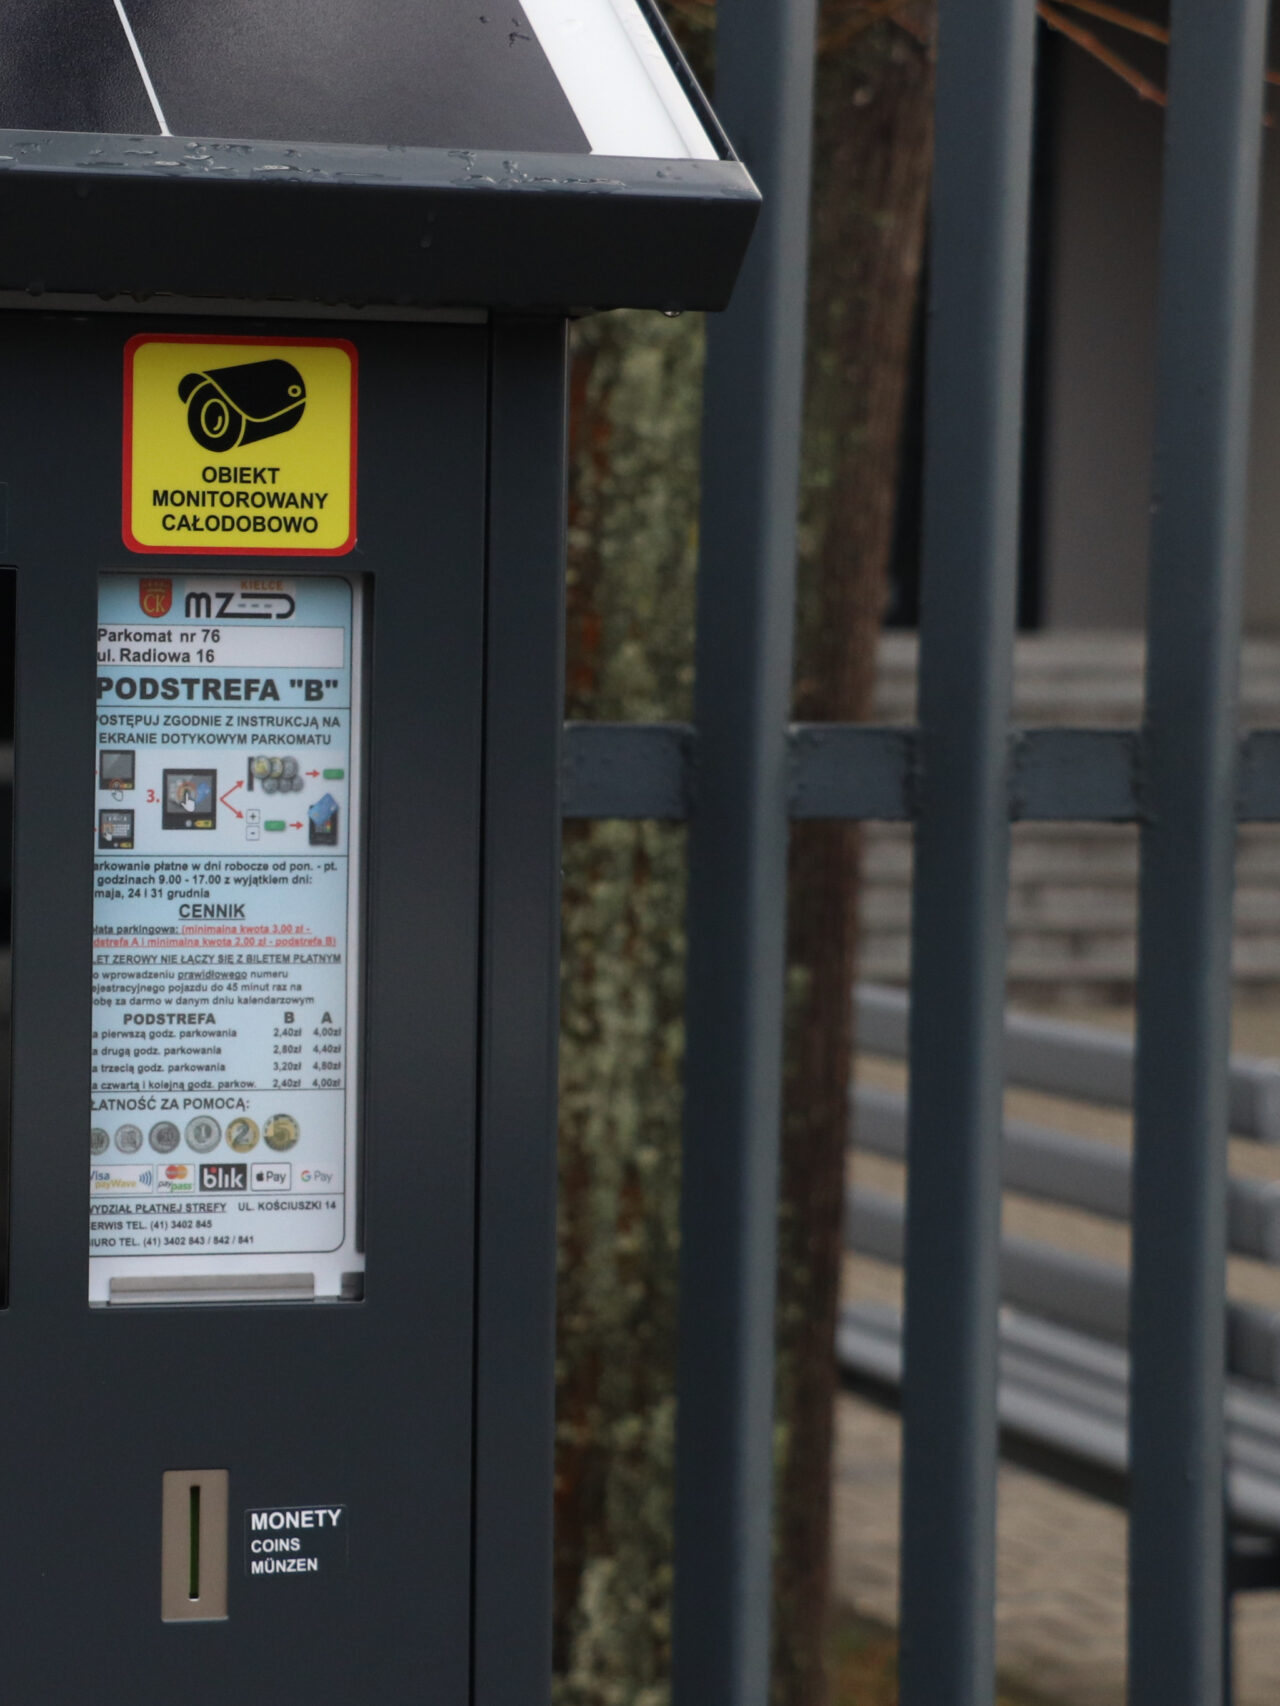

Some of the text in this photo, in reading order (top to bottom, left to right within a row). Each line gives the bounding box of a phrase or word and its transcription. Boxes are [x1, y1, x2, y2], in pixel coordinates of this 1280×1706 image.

[202, 466, 280, 484] OBIEKT
[153, 490, 328, 509] MONITOROWANY
[162, 514, 318, 533] CAŁODOBOWO
[240, 580, 282, 590] KIELCE
[97, 629, 220, 643] Parkomat nr 76
[97, 648, 214, 663] ul. Radiowa 16
[97, 678, 338, 701] PODSTREFA "B"
[96, 715, 340, 730] OSTĘPUJ ZGODNIE Z INSTRUKCJĄ NA
[99, 732, 331, 745] EKRANIE DOTYKOWYM PARKOMATU
[146, 790, 160, 802] 3.
[154, 861, 188, 873] płatne
[204, 861, 221, 871] dni
[225, 862, 269, 871] robocze
[272, 862, 286, 871] od
[290, 864, 313, 874] pon.
[324, 862, 337, 872] pt.
[97, 874, 155, 886] godzinach
[159, 875, 181, 884] 9.00
[193, 875, 221, 884] 17.00
[234, 875, 288, 886] wyjątkiem
[292, 875, 312, 884] dni:
[94, 888, 209, 900] maja, 24 31 grudnia
[179, 904, 245, 920] CENNIK
[117, 925, 178, 936] parkingowa:
[112, 954, 341, 964] ZEROWY NIE ŁĄCZY SIĘ Z BILETEM PŁATNYM
[124, 1012, 332, 1025] PODSTREFA B A
[101, 1027, 342, 1040] pierwszą godz. parkowania 2,40zł 4,00zł
[161, 1099, 179, 1110] ZA
[183, 1098, 248, 1111] POMOCĄ:
[203, 1167, 243, 1188] blik
[266, 1172, 286, 1184] Pay
[314, 1172, 332, 1183] Pay
[136, 1204, 182, 1213] PŁATNEJ
[185, 1203, 226, 1212] STREFY
[238, 1202, 254, 1211] UL.
[258, 1200, 321, 1211] KOŚCIUSZKI
[325, 1201, 336, 1210] 14
[126, 1221, 146, 1230] TEL.
[151, 1221, 168, 1230] (41)
[171, 1220, 192, 1229] 3402
[196, 1220, 212, 1228] 845
[90, 1236, 253, 1247] IURO TEL. (41) 3402 843 842 841
[252, 1509, 341, 1530] MONETY
[251, 1538, 300, 1553] COINS
[252, 1558, 317, 1574] MÜNZEN
